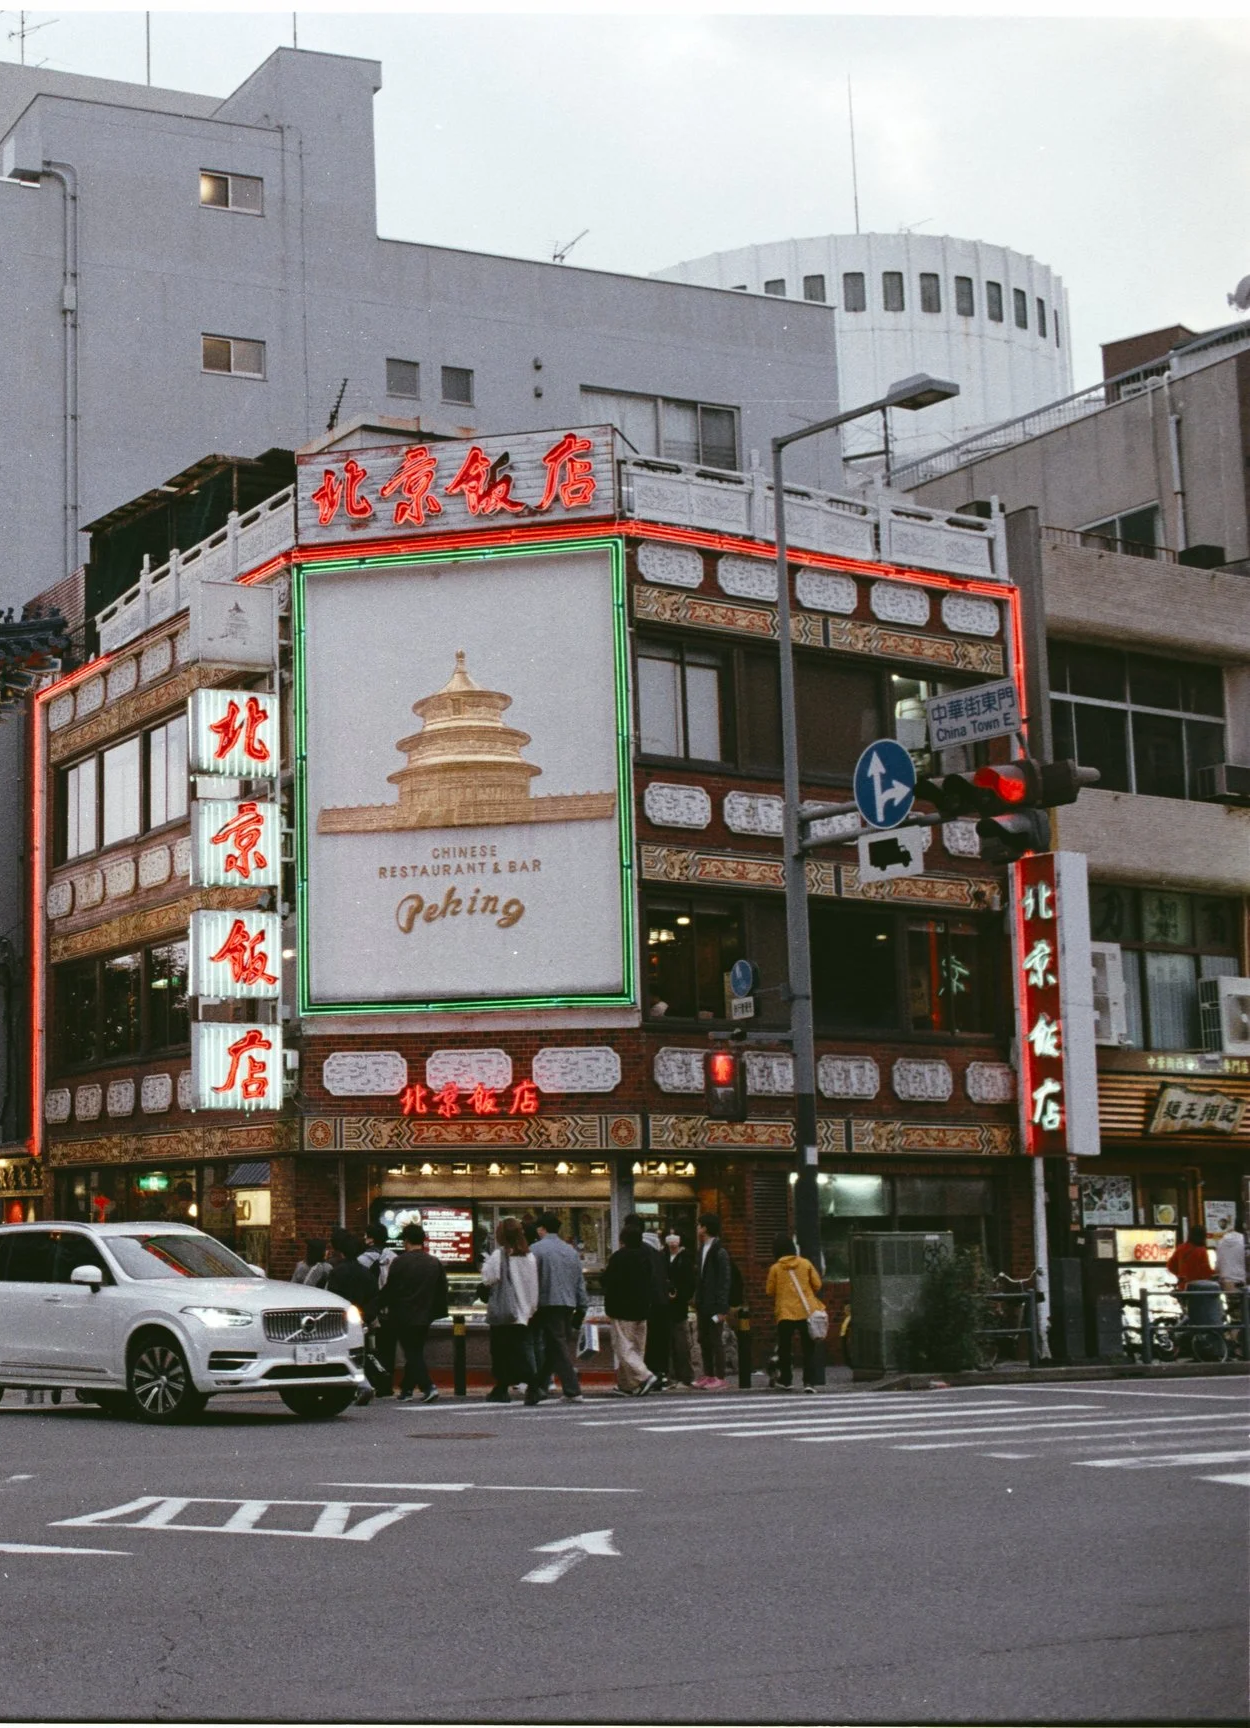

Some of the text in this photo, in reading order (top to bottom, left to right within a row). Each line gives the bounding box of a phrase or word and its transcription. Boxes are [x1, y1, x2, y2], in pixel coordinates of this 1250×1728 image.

[312, 432, 598, 527] 北京飯店
[931, 686, 1015, 724] 中華街東門
[936, 725, 967, 742] China
[970, 719, 1000, 733] Town
[378, 859, 542, 879] RESTAURANT & BAR
[432, 845, 498, 860] CHINESE
[210, 696, 279, 1100] 北京飯店
[396, 885, 526, 934] Peking
[1021, 880, 1062, 1131] 北京飯店
[400, 1079, 539, 1118] 北京飯店
